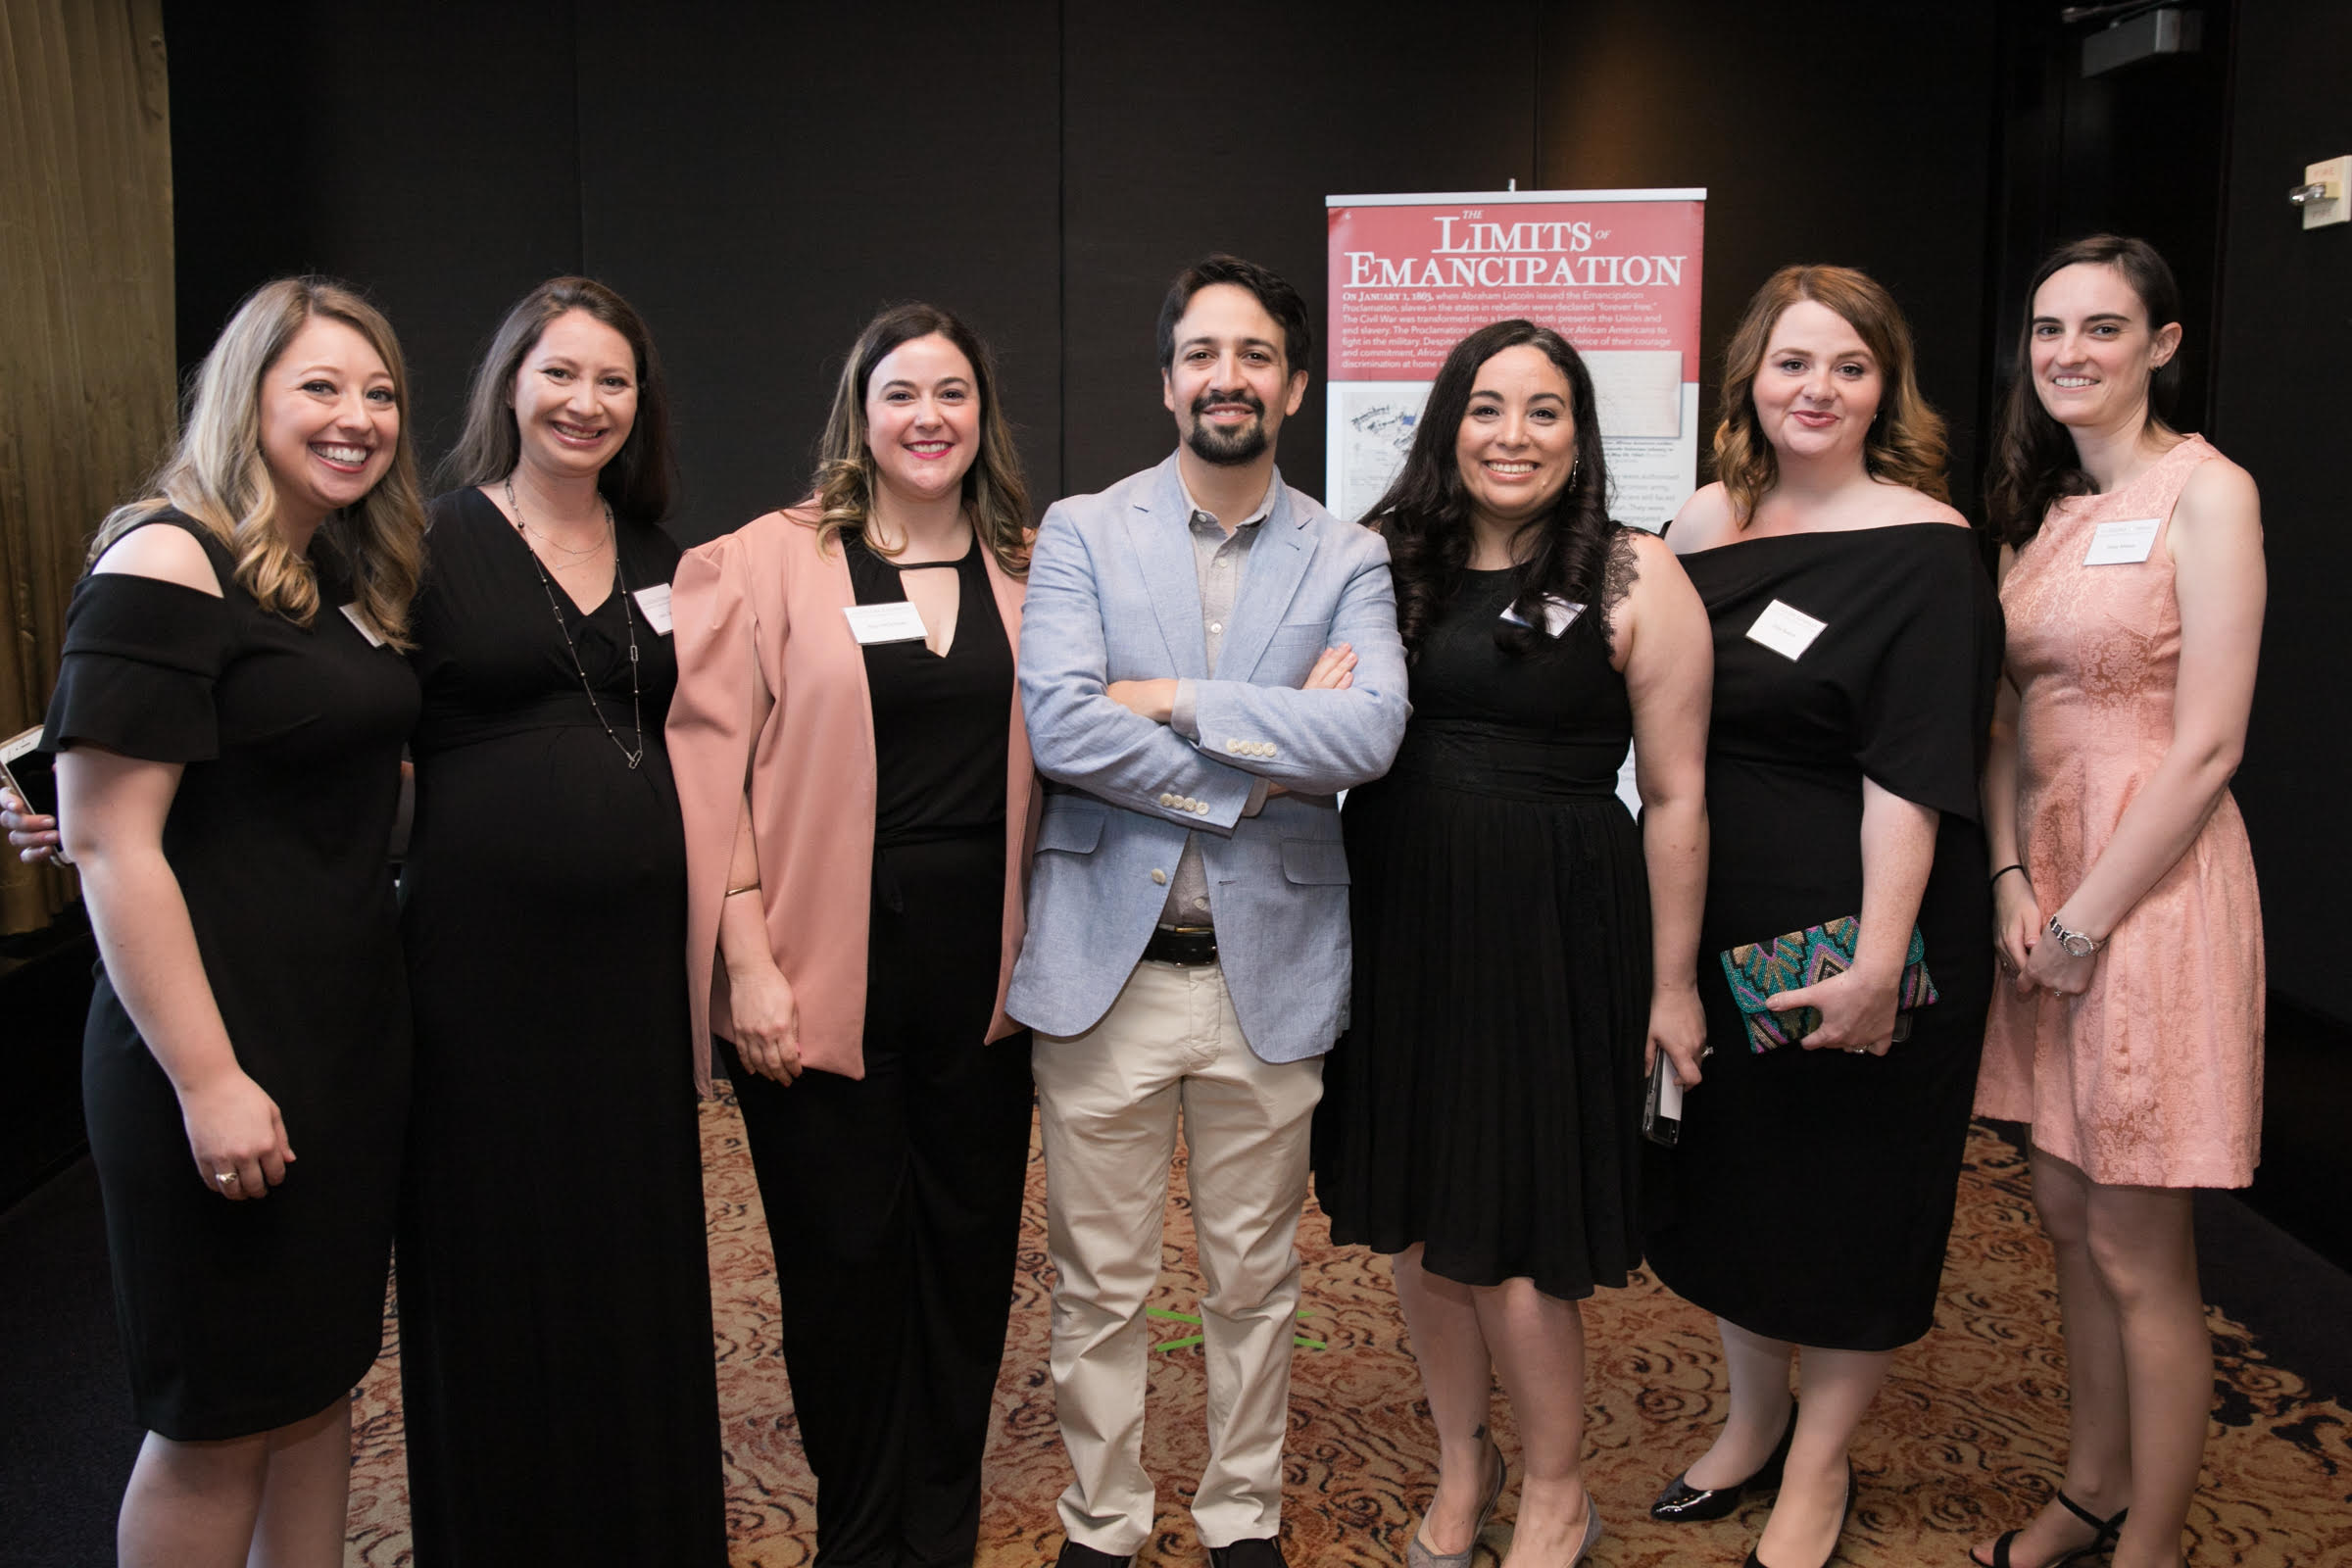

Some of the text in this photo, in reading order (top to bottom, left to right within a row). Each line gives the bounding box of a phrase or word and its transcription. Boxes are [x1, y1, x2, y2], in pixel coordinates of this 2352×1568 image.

[1462, 210, 1484, 220] THE
[1431, 216, 1612, 254] LIMITS OF
[1342, 251, 1688, 288] EMANCIPATION
[1343, 292, 1356, 301] ON
[1358, 292, 1399, 303] JANUARY
[1461, 292, 1501, 301] Abraham
[1536, 291, 1565, 300] issued
[1583, 291, 1644, 301] Emancipation
[1343, 304, 1399, 314] Proclamation,
[1400, 304, 1428, 313] slaves
[1492, 303, 1531, 312] rebellion
[1555, 303, 1595, 312] declared
[1343, 315, 1358, 323] The
[1360, 315, 1378, 323] Civil
[1380, 315, 1397, 323] War
[1535, 314, 1557, 322] both
[1558, 316, 1597, 325] preserve
[1598, 314, 1614, 322] the
[1615, 314, 1642, 322] Union
[1643, 314, 1662, 322] and
[1561, 325, 1575, 334] for
[1342, 337, 1361, 347] fight
[1423, 337, 1458, 347] Despite
[1634, 339, 1671, 348] courage
